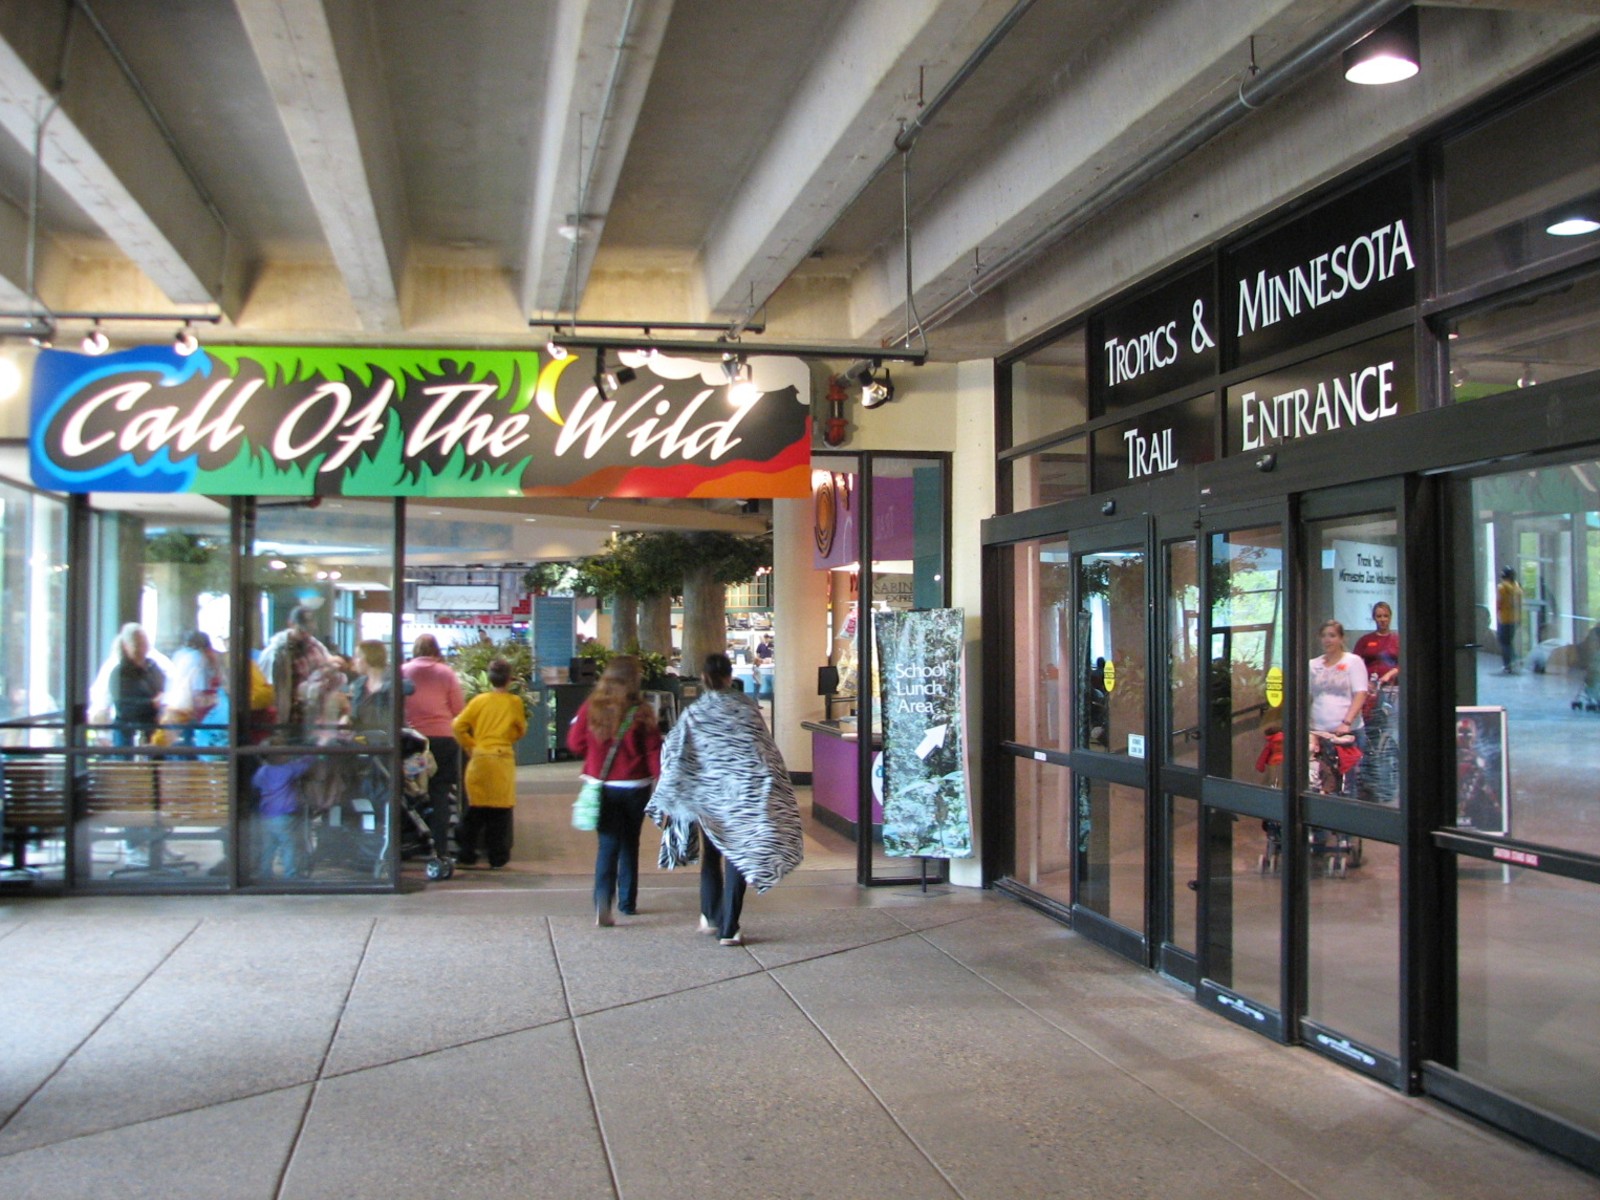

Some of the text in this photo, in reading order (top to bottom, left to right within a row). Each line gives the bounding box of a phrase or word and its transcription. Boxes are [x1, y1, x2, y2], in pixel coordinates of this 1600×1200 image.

[1191, 298, 1215, 354] &
[1237, 219, 1415, 338] MINNESOTA
[61, 377, 765, 473] Call Of The Wild
[1124, 361, 1398, 480] TRAIL ENTRANCE
[895, 663, 946, 679] School
[897, 681, 942, 696] Lunch
[897, 700, 935, 713] Area
